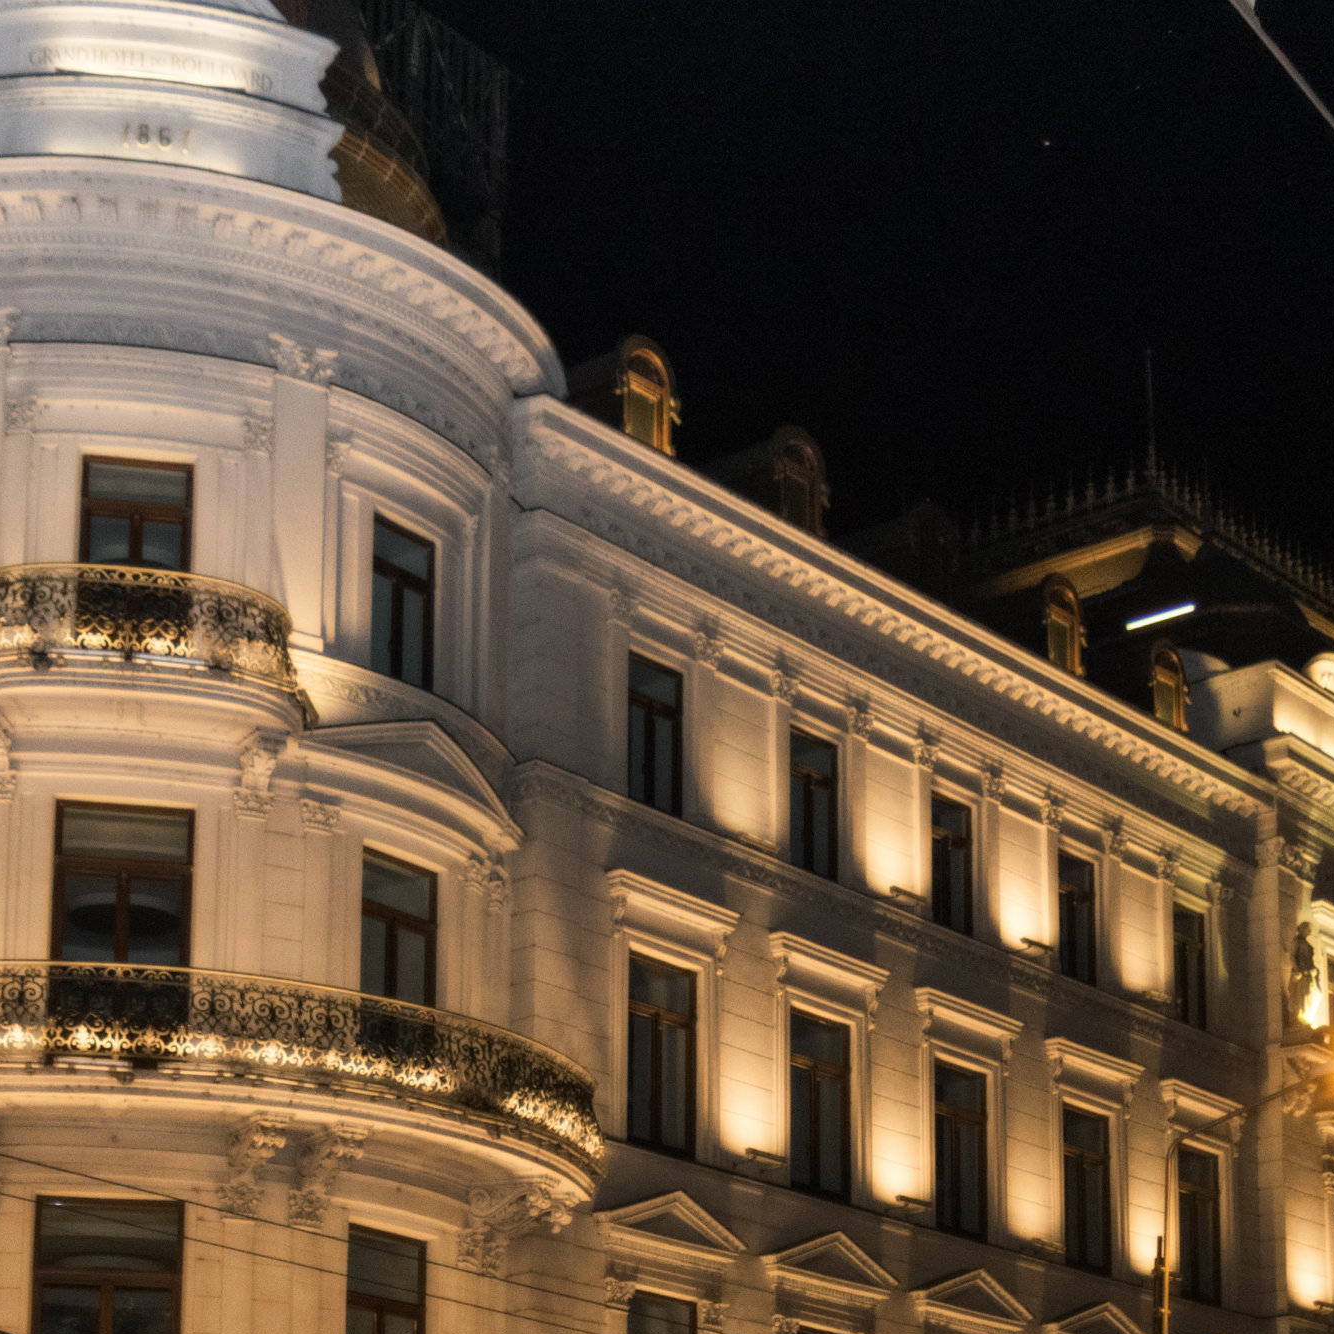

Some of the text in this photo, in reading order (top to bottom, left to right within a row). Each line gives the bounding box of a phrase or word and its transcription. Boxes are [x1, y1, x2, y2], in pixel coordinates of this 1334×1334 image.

[28, 47, 90, 67] GRAND
[92, 47, 147, 68] HOTEL
[170, 55, 274, 93] BOULEVARD
